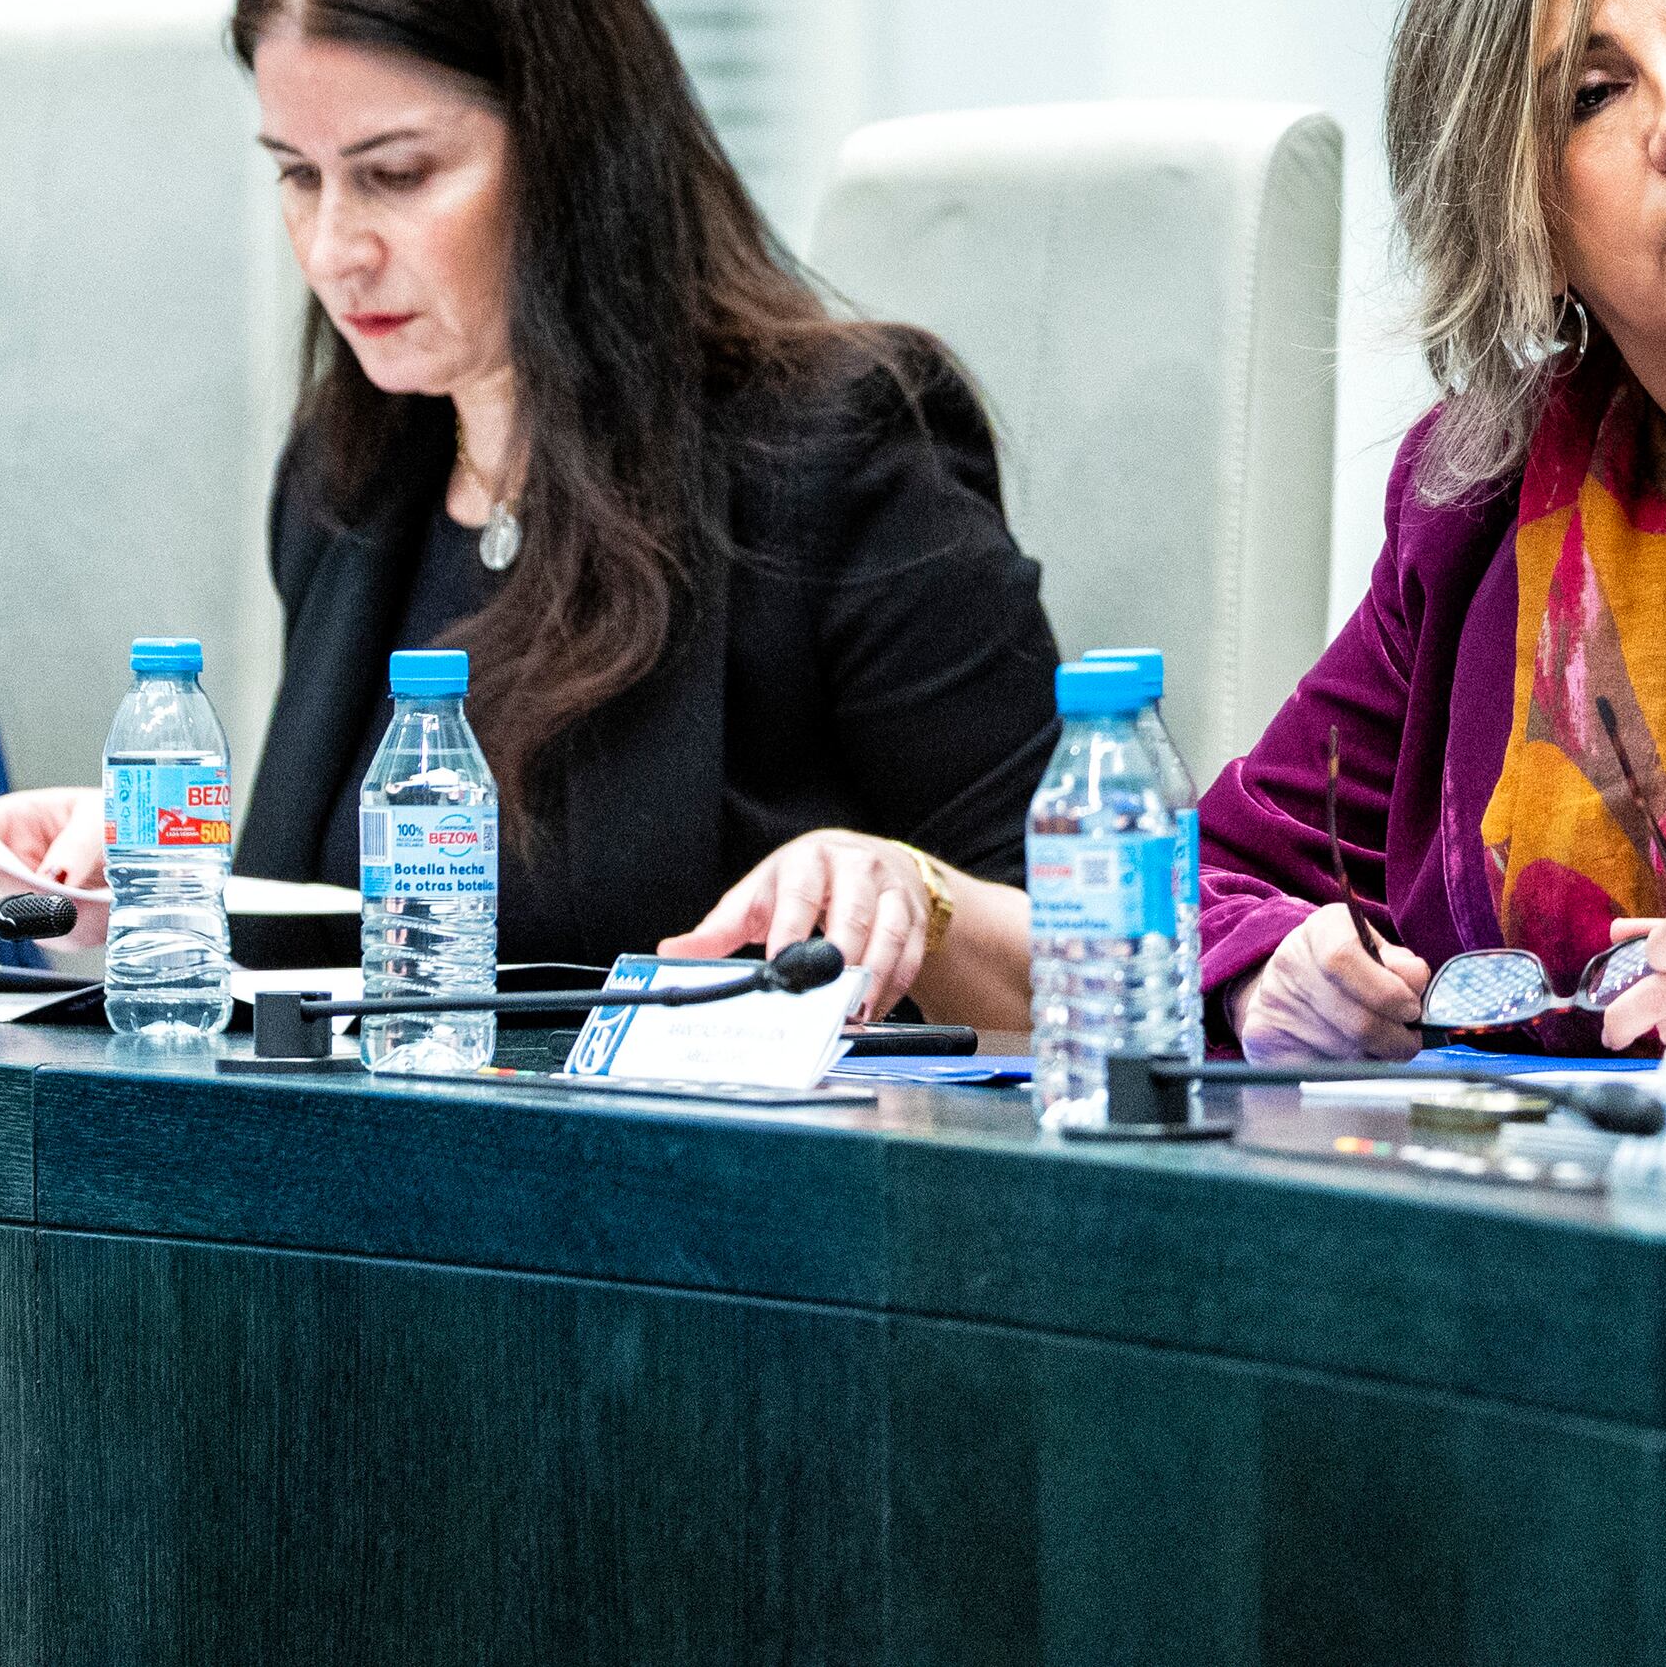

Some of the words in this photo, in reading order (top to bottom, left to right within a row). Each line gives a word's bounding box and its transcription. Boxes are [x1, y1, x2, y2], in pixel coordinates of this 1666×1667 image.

[396, 823, 424, 836] 100%
[428, 832, 479, 844] BEZOYA
[393, 863, 445, 875] Botella
[449, 863, 485, 875] hecha
[394, 879, 411, 891] de
[415, 880, 453, 891] otras
